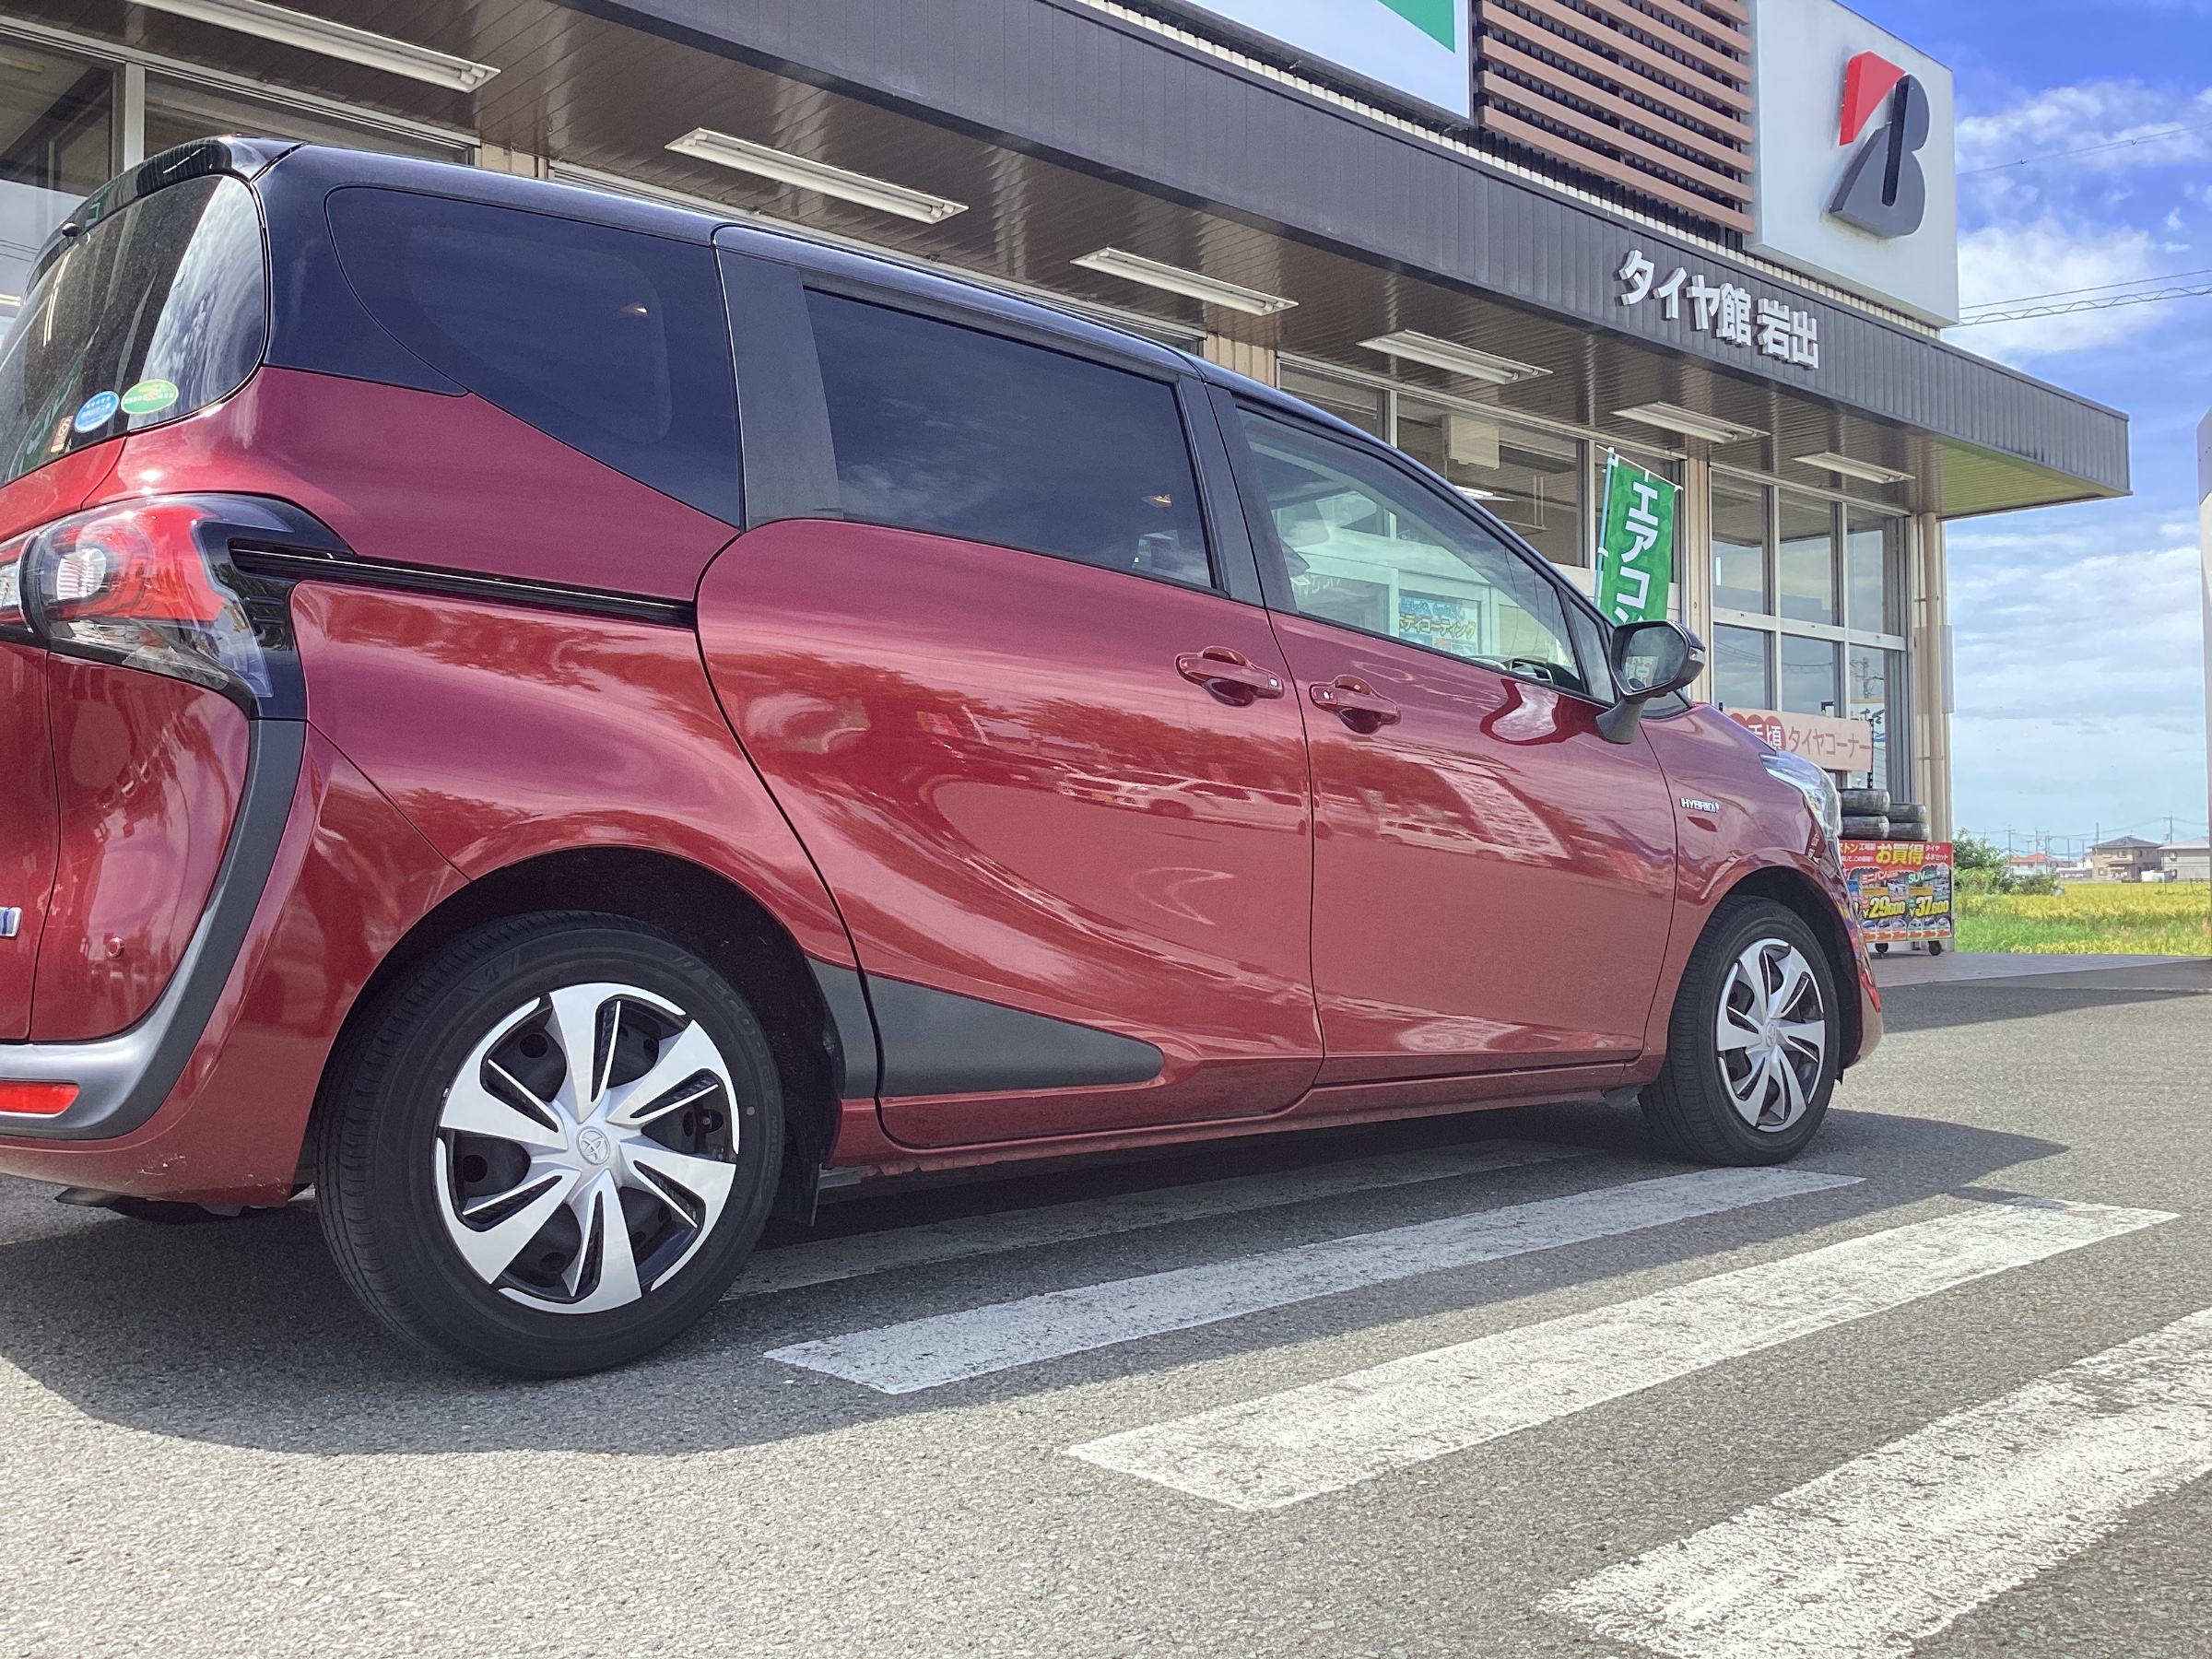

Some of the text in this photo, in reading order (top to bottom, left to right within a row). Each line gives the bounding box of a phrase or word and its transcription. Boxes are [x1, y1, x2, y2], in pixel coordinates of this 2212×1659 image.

[1619, 249, 1819, 370] タイヤ館 岩出
[1788, 725, 1871, 759] タイヤコーナー
[1876, 843, 1924, 865] お買得
[1908, 871, 1925, 884] SUV
